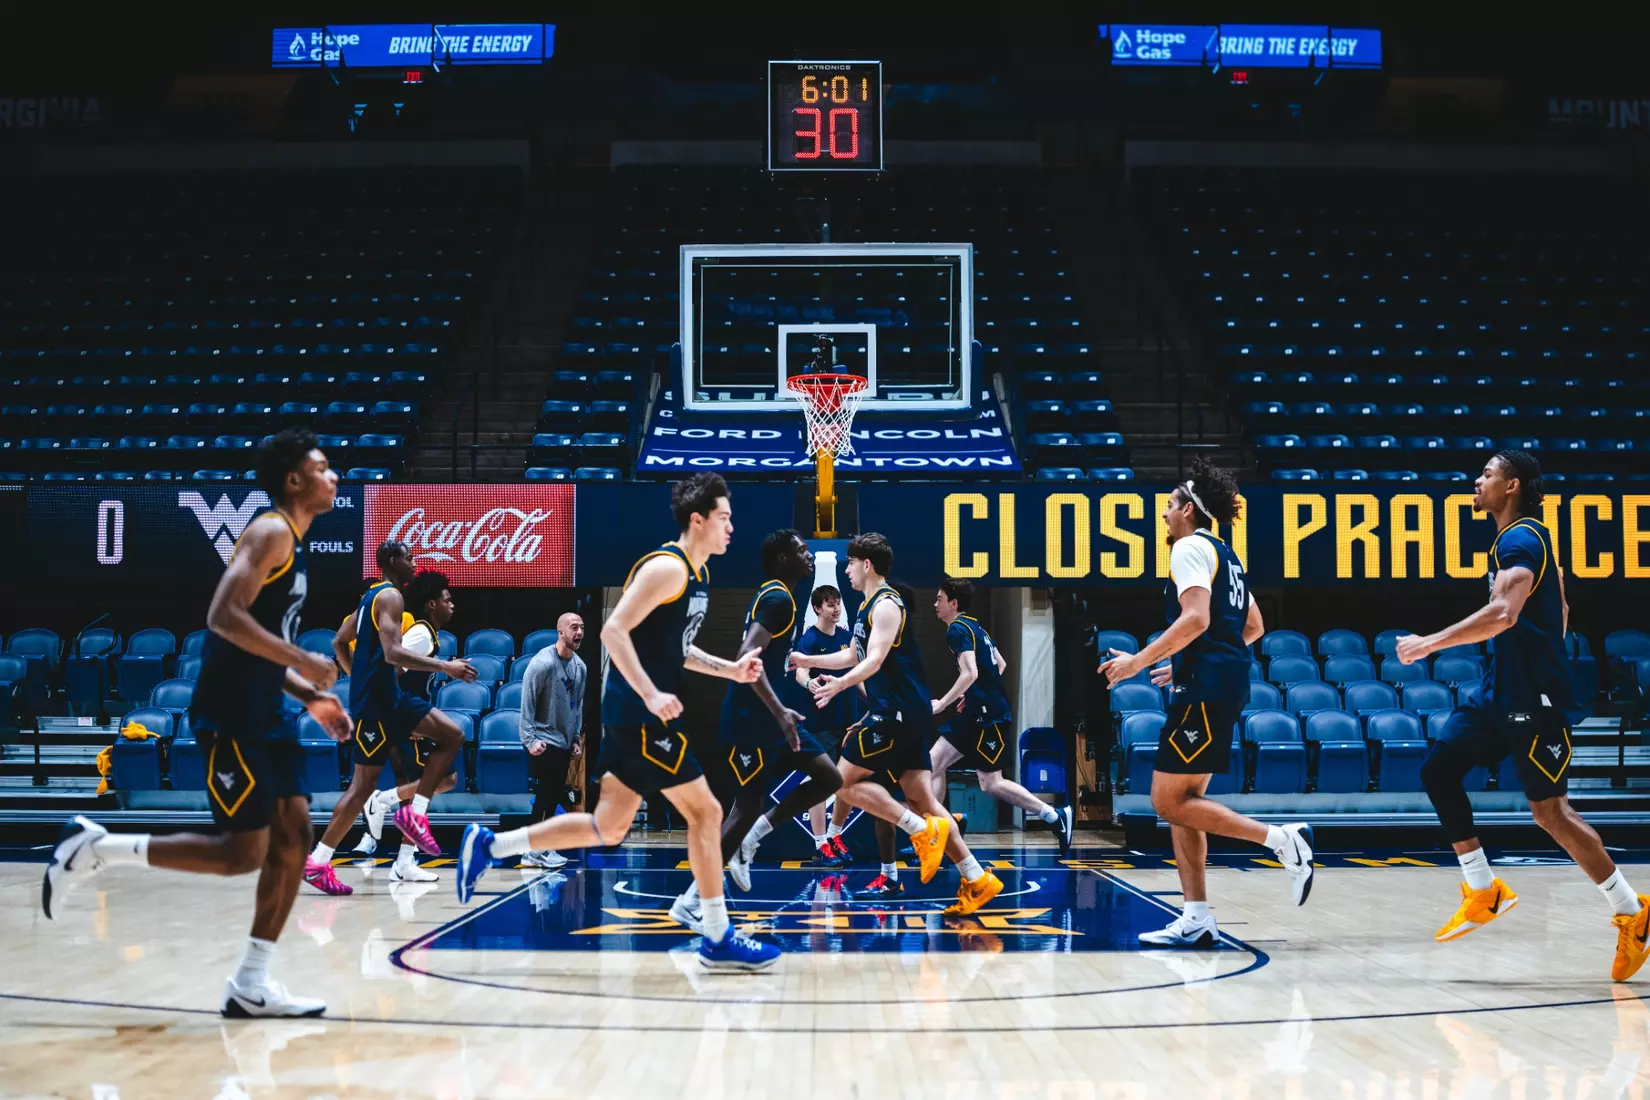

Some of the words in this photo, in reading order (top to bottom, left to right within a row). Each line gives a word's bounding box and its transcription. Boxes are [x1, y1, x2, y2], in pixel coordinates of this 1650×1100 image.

[311, 32, 360, 48] Hope
[389, 36, 438, 54] BRING
[442, 35, 469, 53] THE
[472, 35, 532, 53] ENERGY
[1136, 30, 1186, 45] Hope
[1216, 36, 1264, 54] BRING
[1268, 38, 1295, 55] THE
[1299, 38, 1357, 56] ENERGY
[1136, 45, 1171, 59] Gas
[802, 75, 867, 104] 6:01
[793, 108, 859, 158] 30
[653, 427, 782, 439] FORD
[798, 427, 1003, 440] NCOLN
[645, 455, 1013, 467] MORGANTOWN
[1283, 493, 1650, 579] PRACICE
[309, 540, 354, 553] FOULS
[1227, 559, 1245, 610] 55
